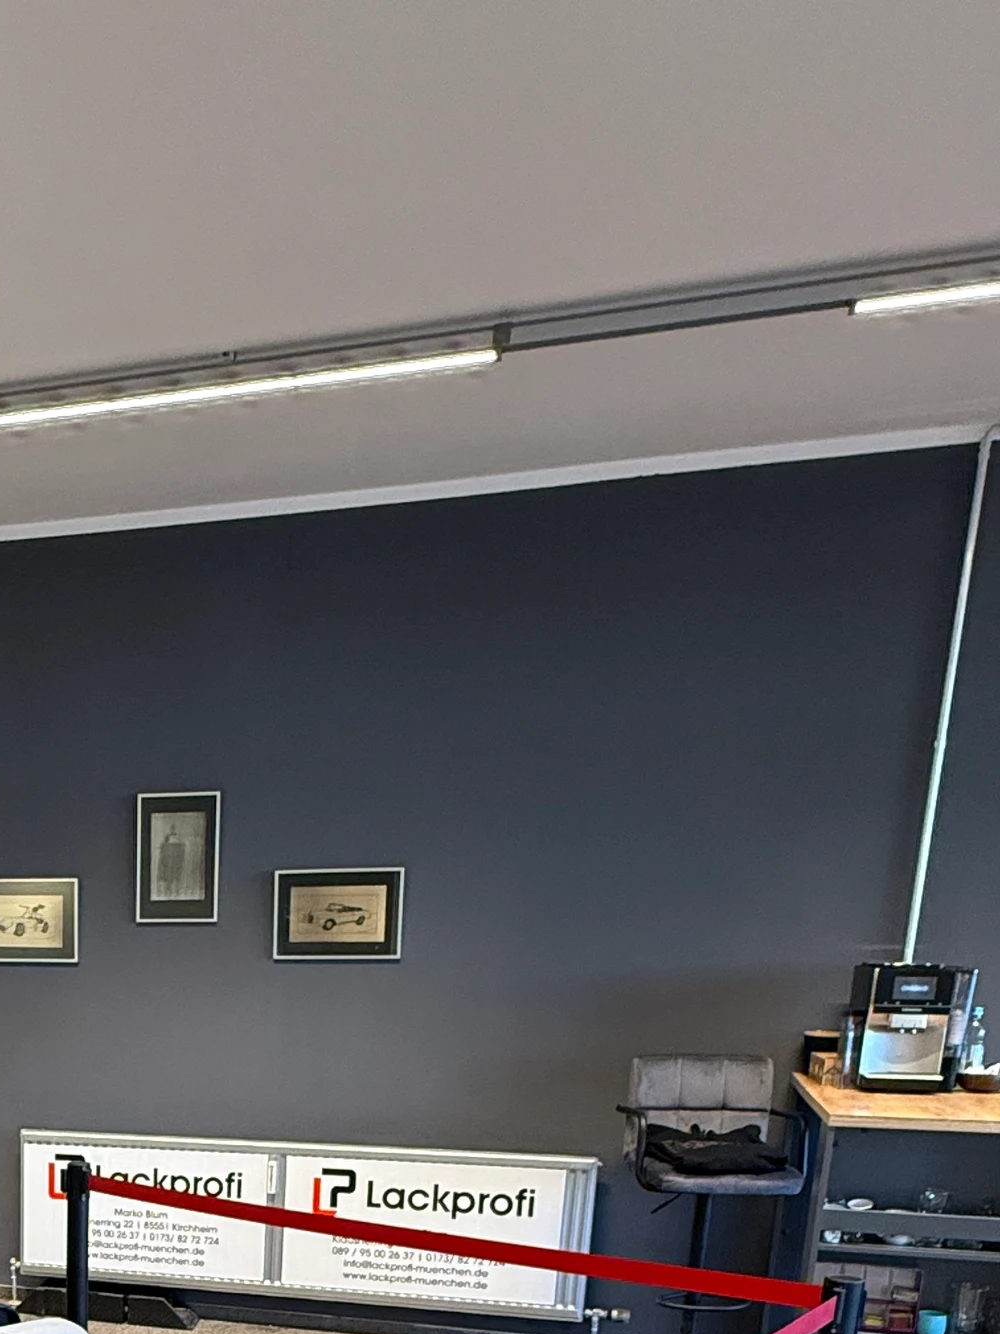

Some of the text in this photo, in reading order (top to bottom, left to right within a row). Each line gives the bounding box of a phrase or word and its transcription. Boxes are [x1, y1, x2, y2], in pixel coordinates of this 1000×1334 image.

[366, 1180, 536, 1220] Lackprofi
[114, 1208, 168, 1219] Marko Blum
[89, 1219, 121, 1229] nerring
[123, 1220, 133, 1228] 22
[172, 1223, 218, 1234] Kirchheim
[92, 1229, 102, 1237] 95
[104, 1230, 115, 1238] 00
[117, 1231, 127, 1239] 26
[129, 1231, 139, 1240] 37
[177, 1234, 188, 1243] 82
[190, 1235, 201, 1244] 72
[203, 1236, 220, 1245] 724
[332, 1246, 350, 1255] 089
[359, 1248, 371, 1257] 95
[374, 1249, 386, 1259] 00
[388, 1250, 400, 1260] 26
[402, 1250, 415, 1260] 37
[343, 1259, 489, 1278] info@lackprofi-muenchen.de
[342, 1271, 489, 1290] www.lackprofi-muenchen.de
